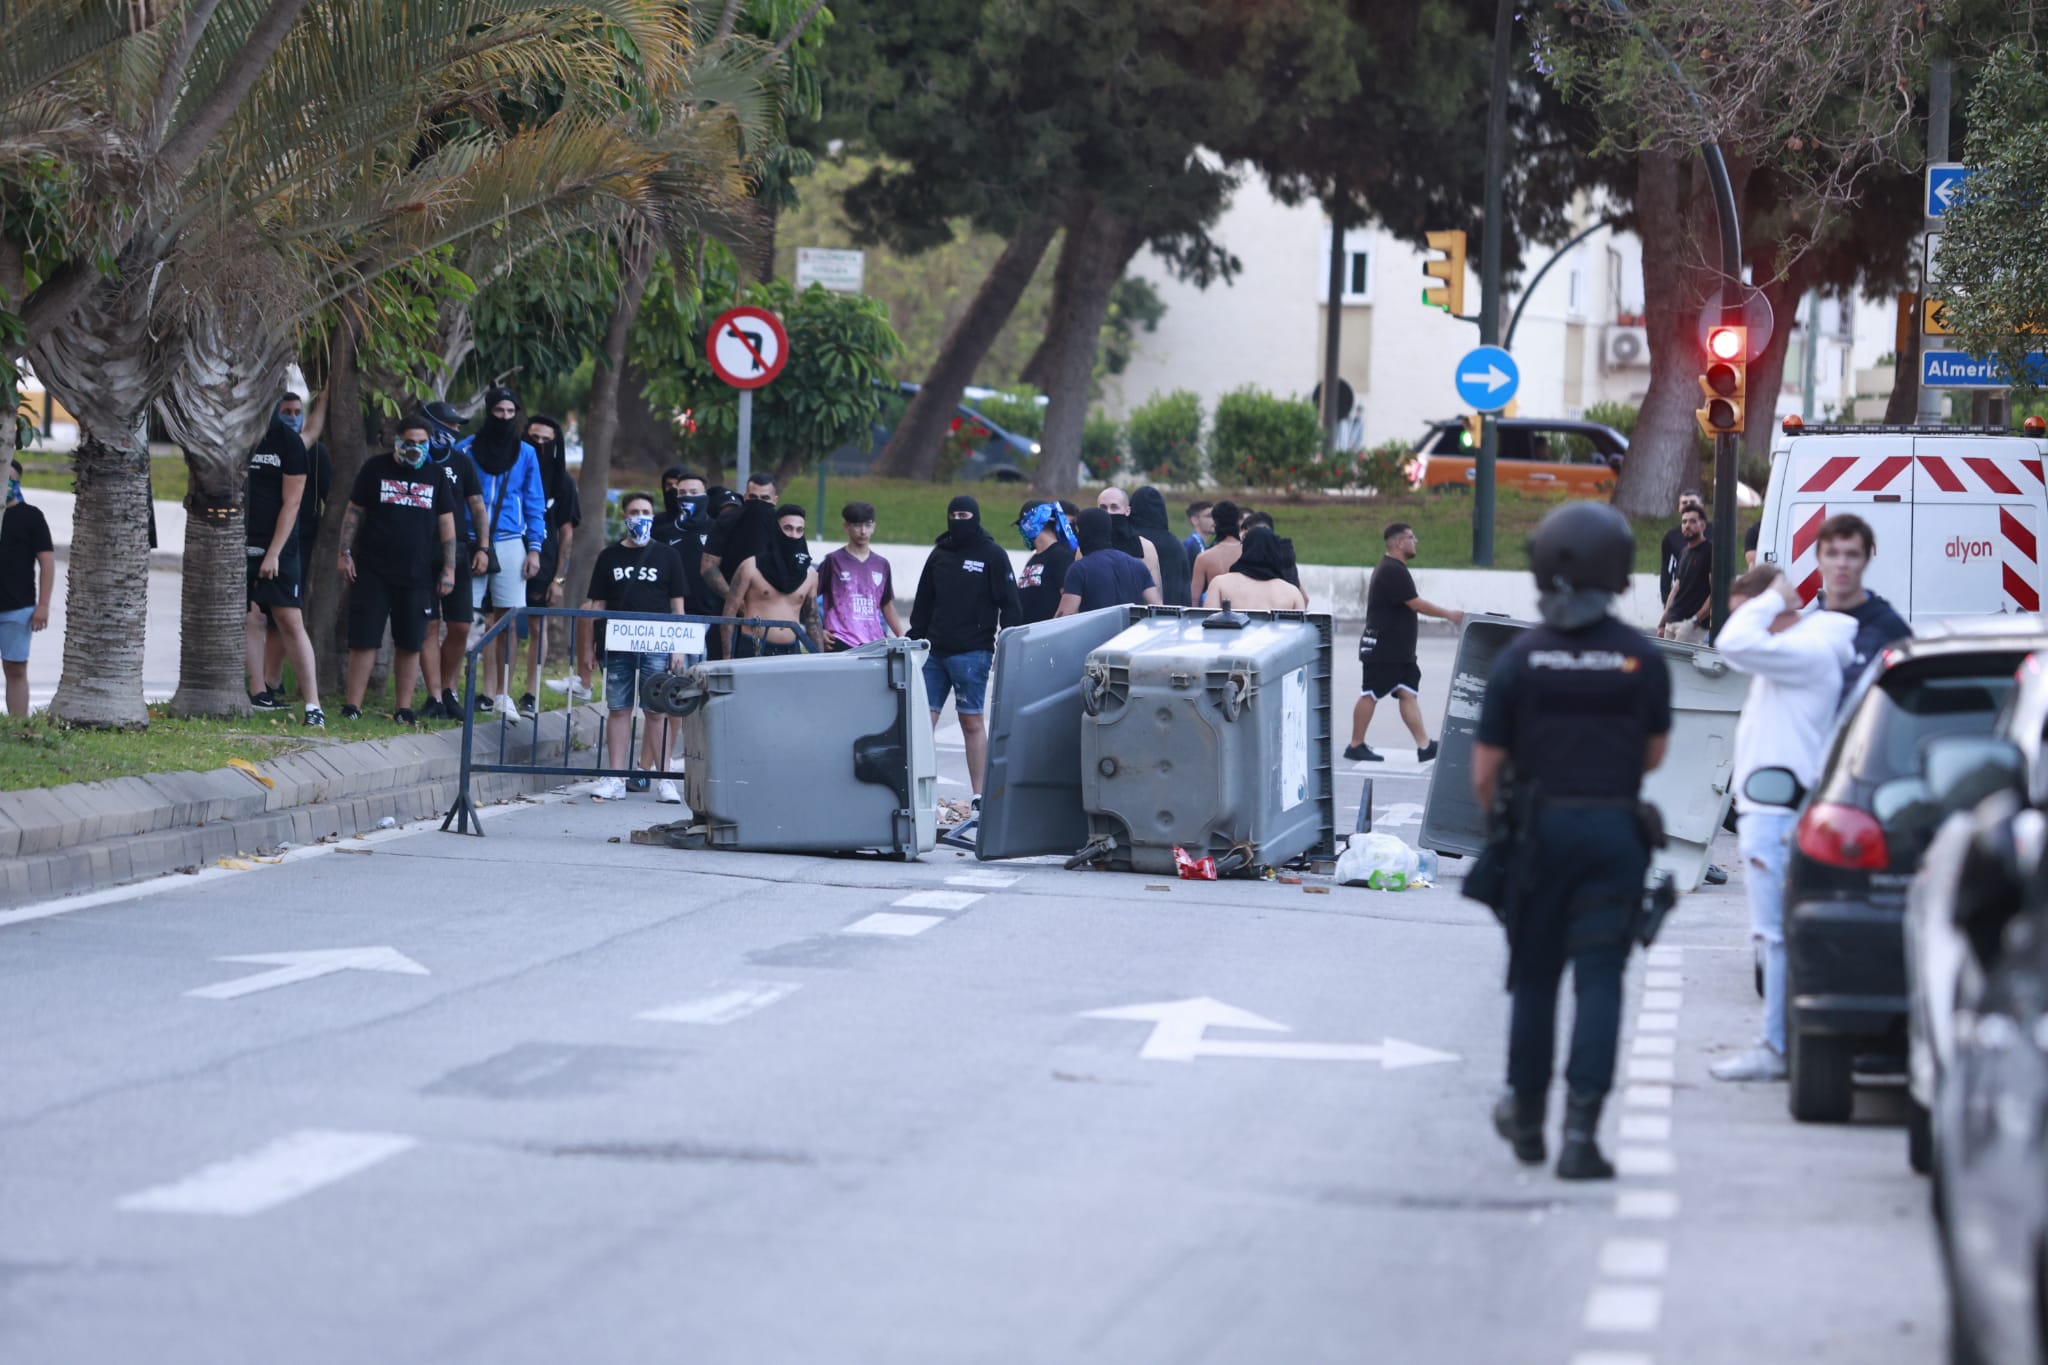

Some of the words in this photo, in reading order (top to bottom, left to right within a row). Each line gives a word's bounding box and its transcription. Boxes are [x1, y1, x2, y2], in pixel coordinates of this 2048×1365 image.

[1945, 535, 1993, 565] alyon
[612, 624, 655, 637] POLICIA
[660, 626, 696, 639] LOCAL
[630, 639, 676, 652] MALAGA
